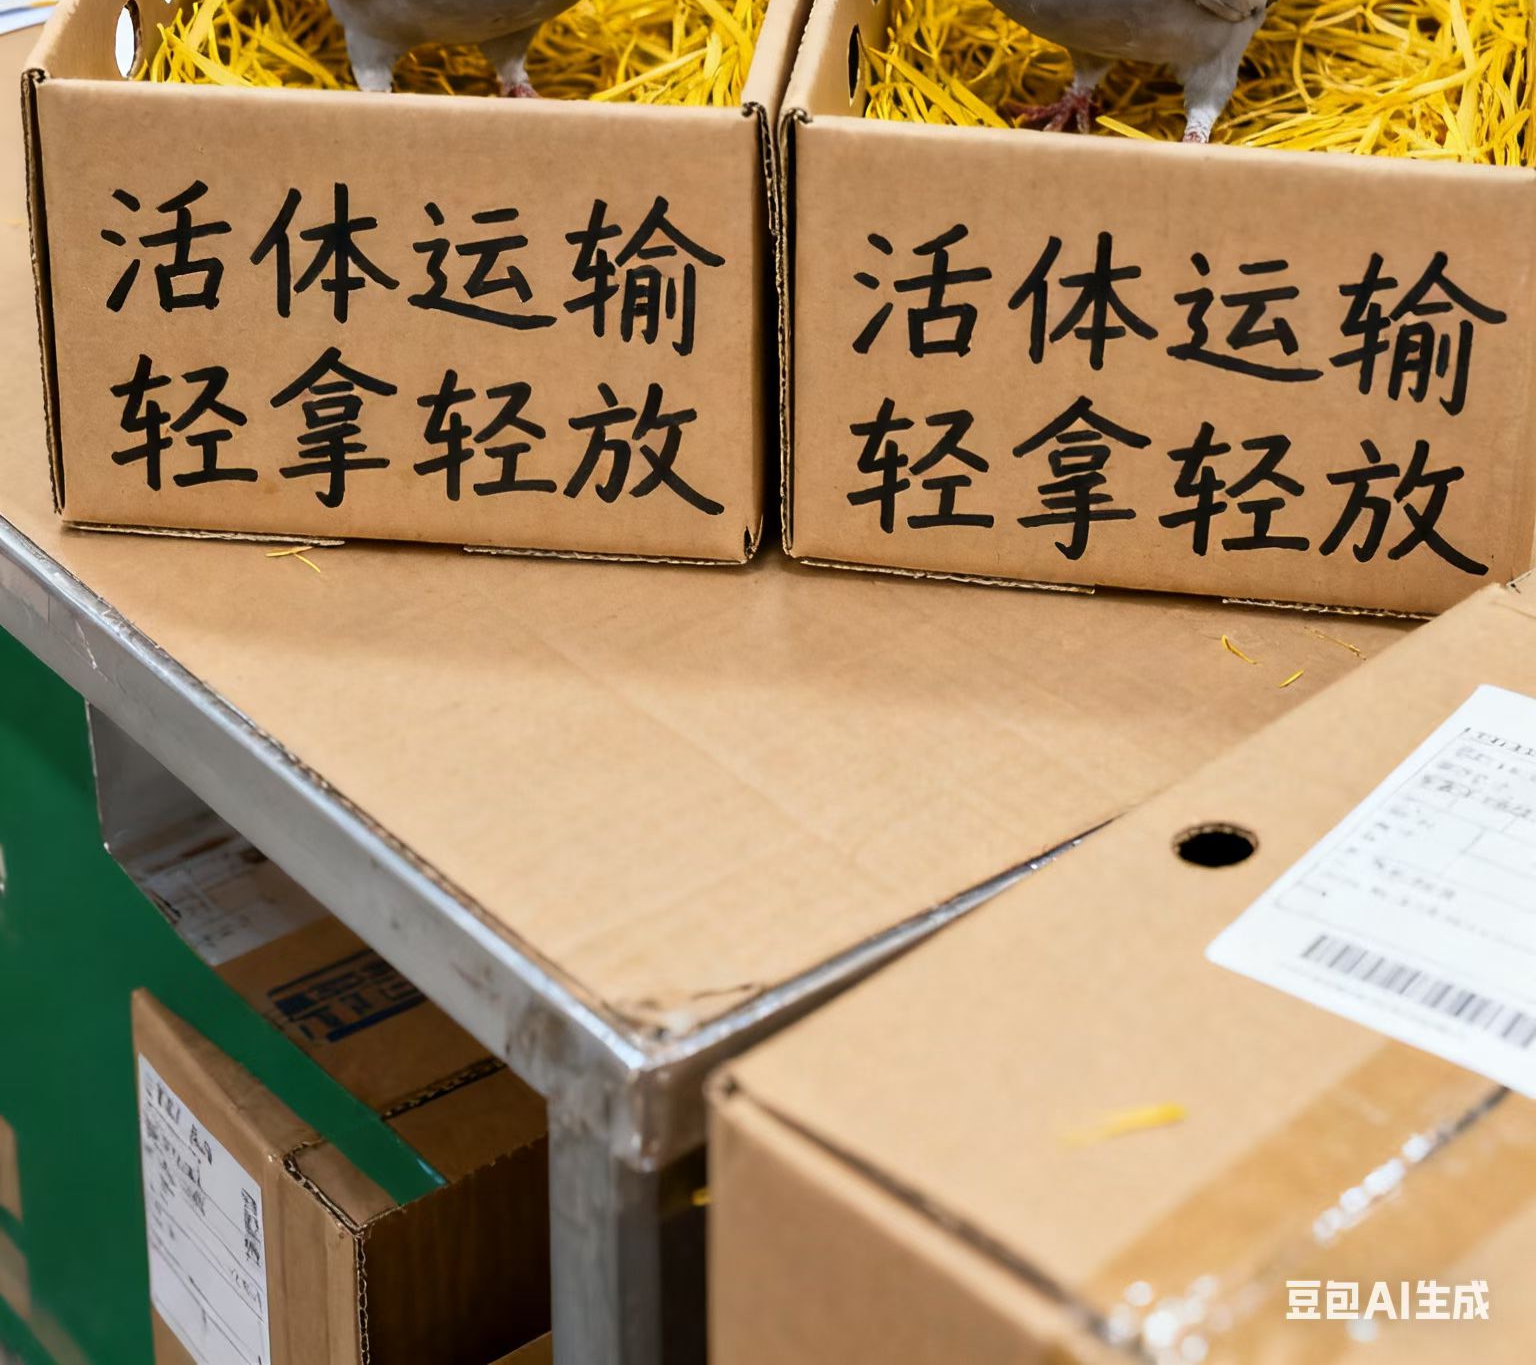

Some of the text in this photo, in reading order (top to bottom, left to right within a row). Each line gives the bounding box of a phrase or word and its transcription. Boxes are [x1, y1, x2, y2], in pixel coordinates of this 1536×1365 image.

[101, 180, 726, 357] 活体运输
[852, 223, 1507, 417] 活体运输
[110, 346, 726, 516] 轻拿轻放
[847, 395, 1490, 577] 轻拿轻放
